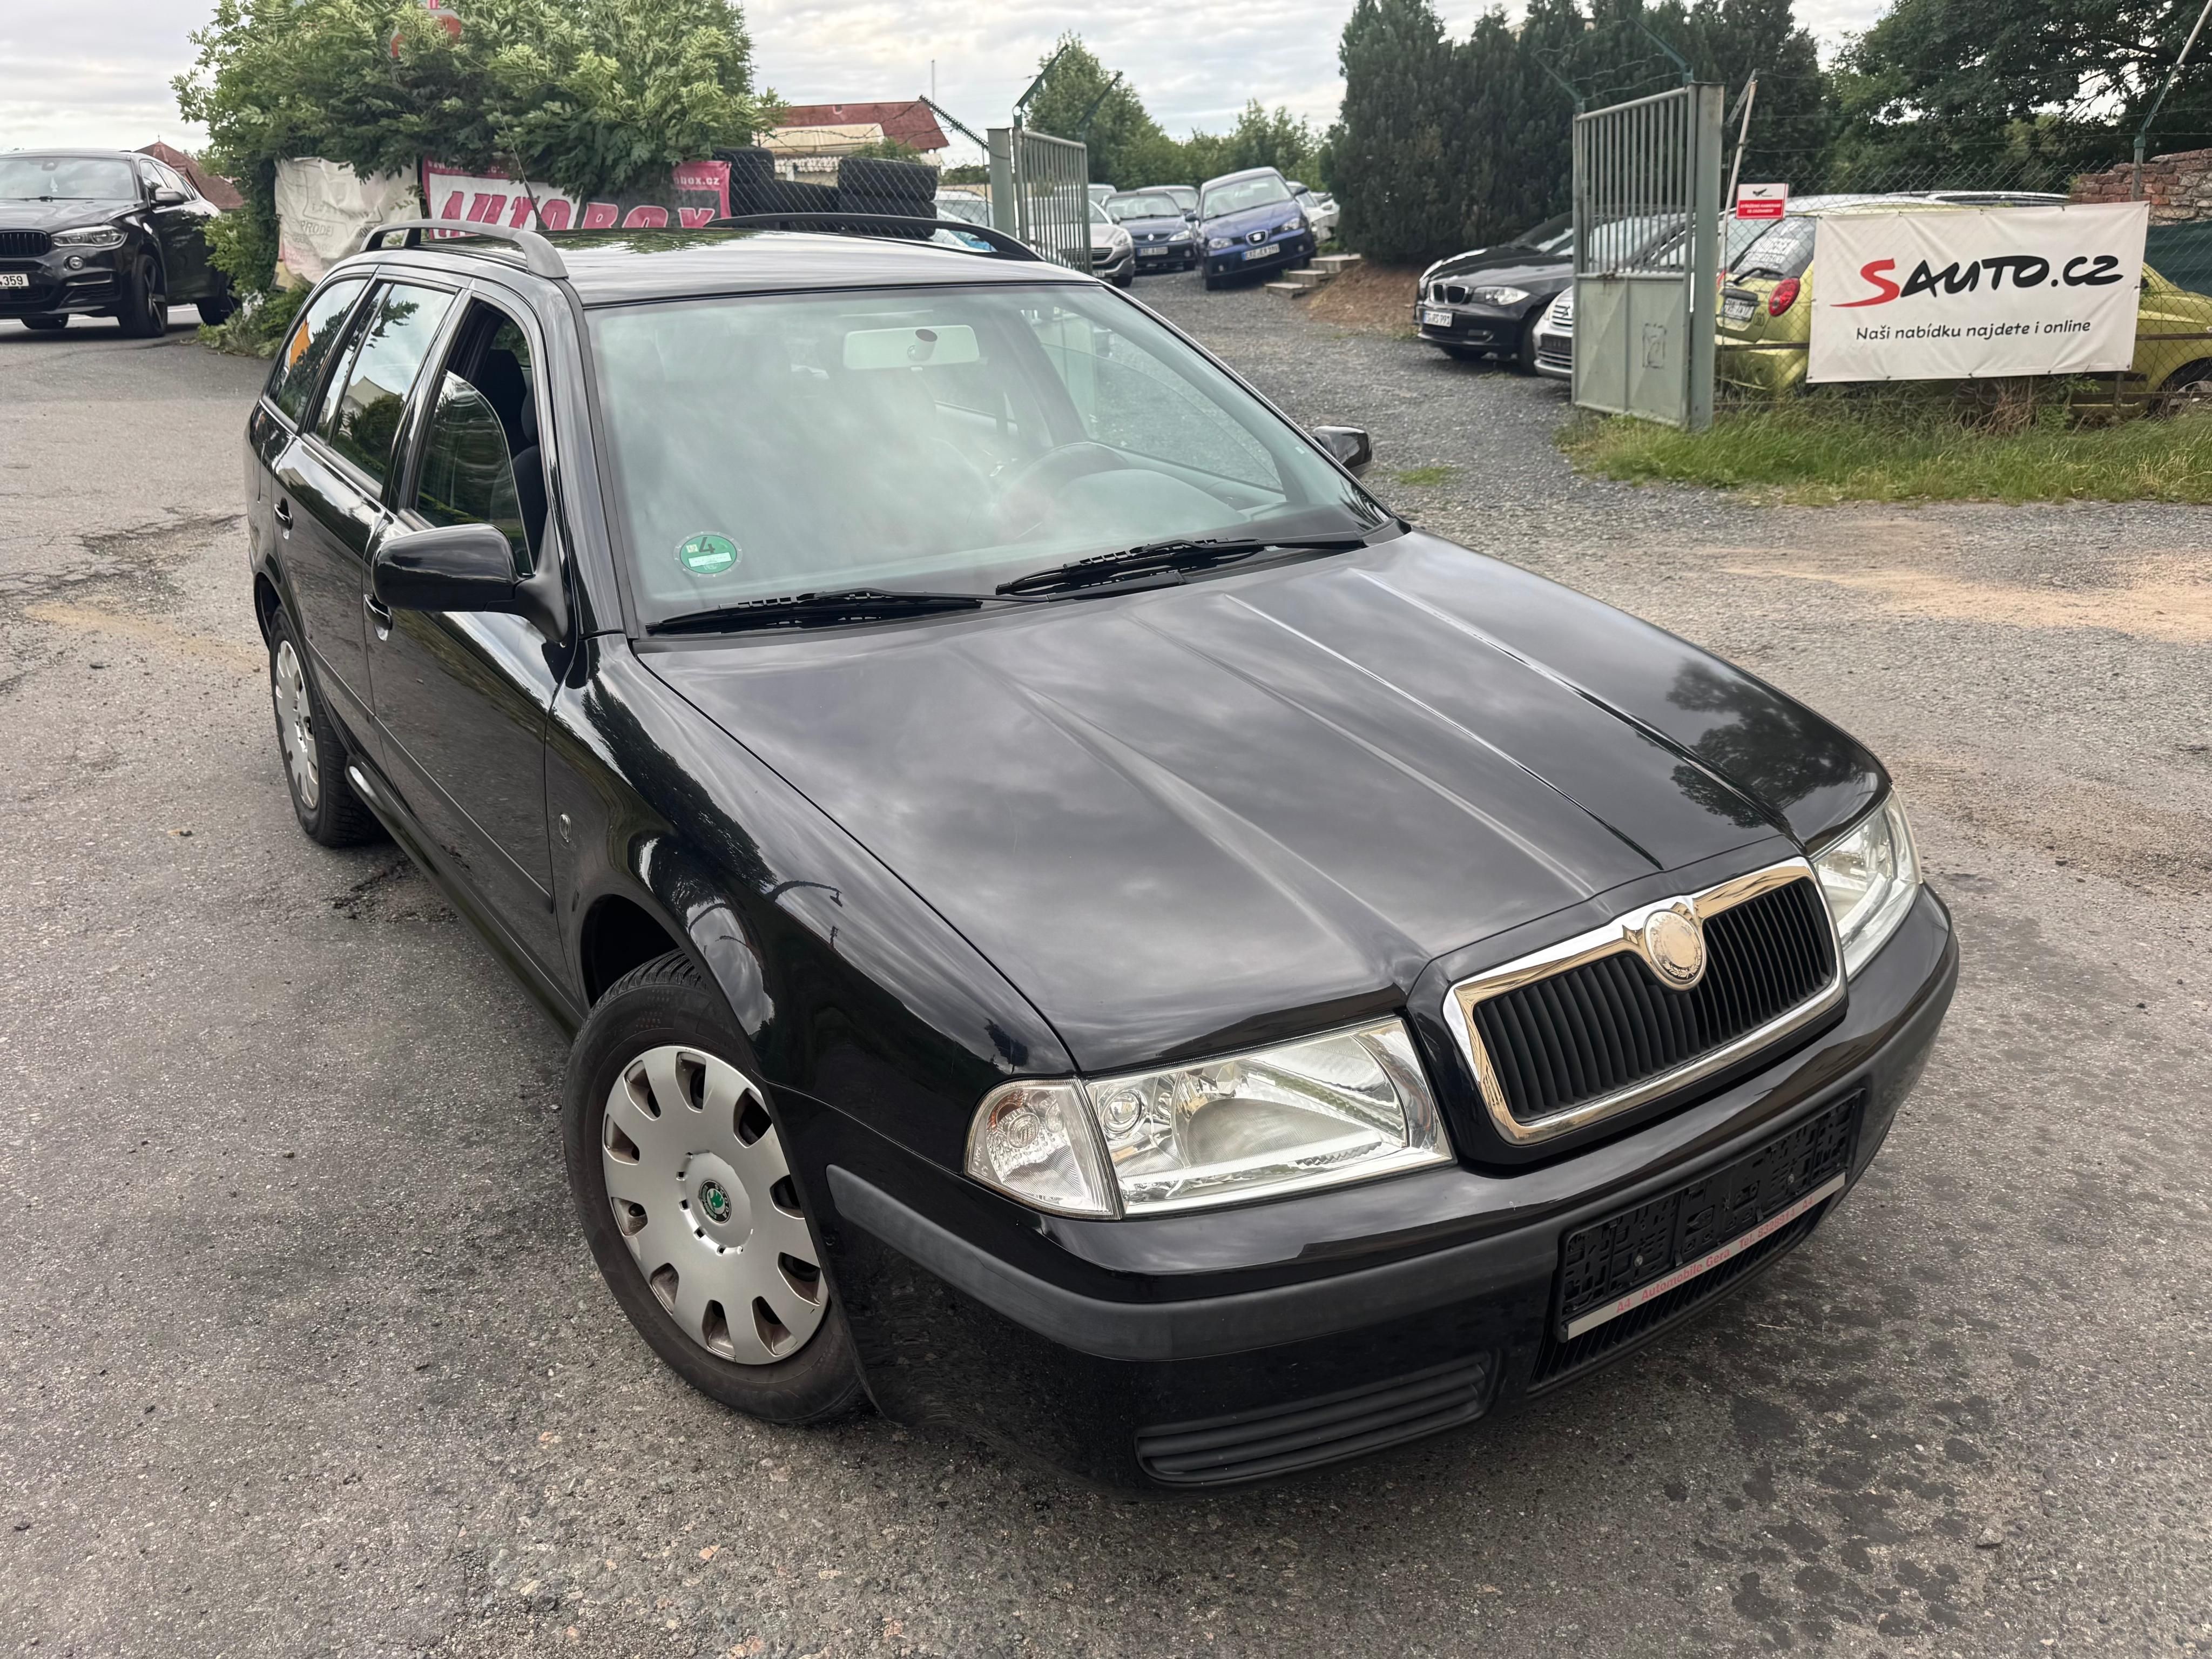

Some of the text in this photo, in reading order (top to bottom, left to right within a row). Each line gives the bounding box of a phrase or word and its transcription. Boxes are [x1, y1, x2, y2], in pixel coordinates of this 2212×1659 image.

[0, 275, 23, 286] 359
[1856, 320, 2091, 340] Naši nabídku najdete i online
[699, 537, 716, 553] 4
[1616, 1298, 1631, 1313] A4
[1641, 1264, 1703, 1300] Automobile
[1705, 1249, 1731, 1267] Gera
[1739, 1233, 1755, 1249] Tel.
